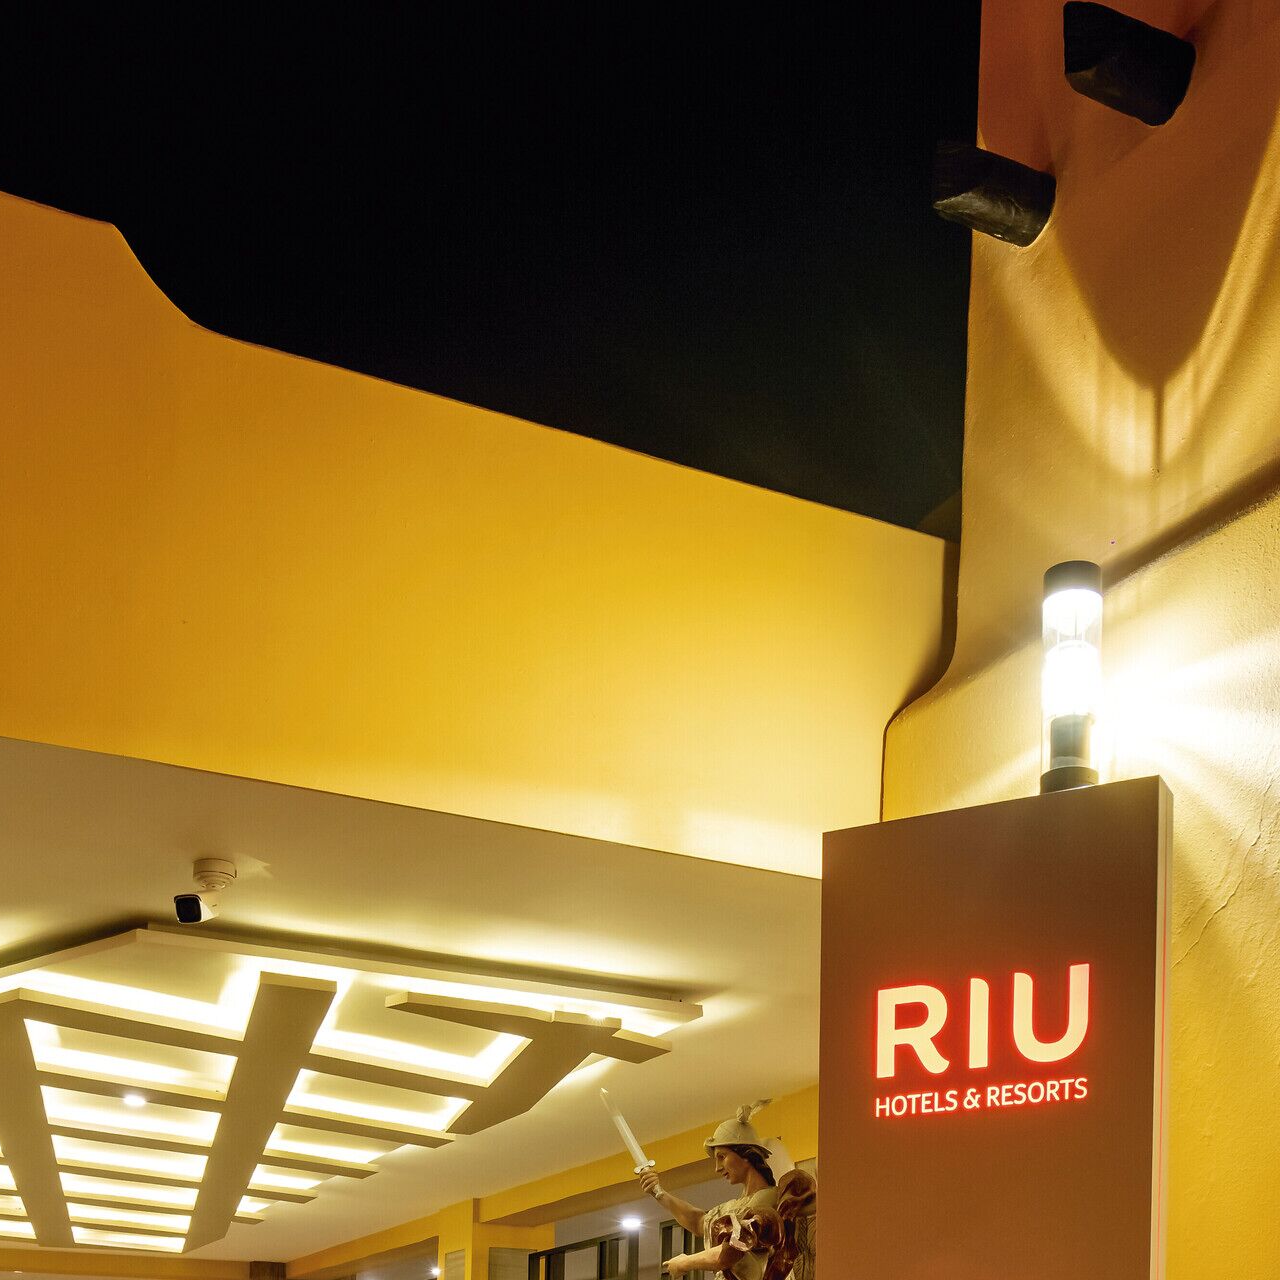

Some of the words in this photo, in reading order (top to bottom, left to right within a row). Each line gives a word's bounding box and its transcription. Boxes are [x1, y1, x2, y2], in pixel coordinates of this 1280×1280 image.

[876, 963, 1090, 1079] RIU
[875, 1089, 959, 1118] HOTELS
[963, 1087, 981, 1109] &
[986, 1077, 1089, 1107] RESORTS
